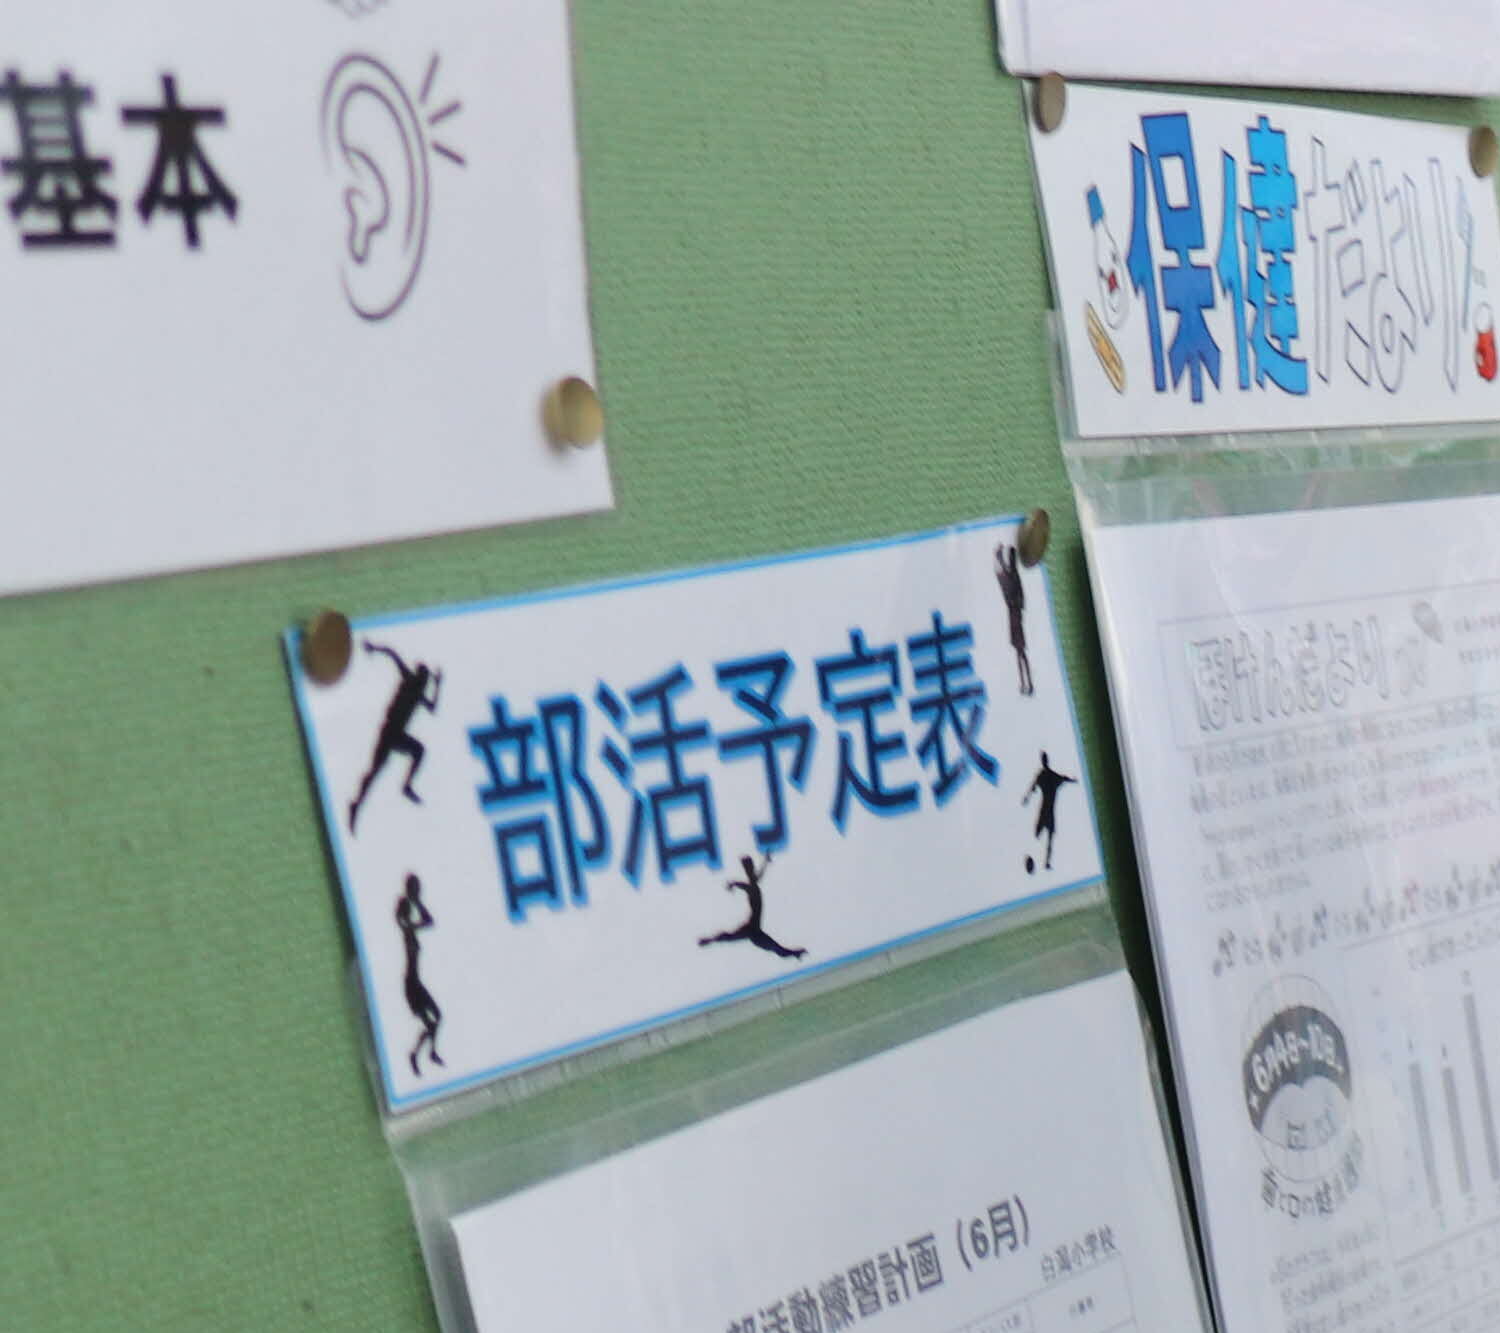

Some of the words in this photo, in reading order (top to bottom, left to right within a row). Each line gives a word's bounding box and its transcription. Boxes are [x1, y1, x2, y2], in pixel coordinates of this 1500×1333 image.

[0, 70, 239, 249] 基本
[465, 612, 1000, 924] 部活予定表
